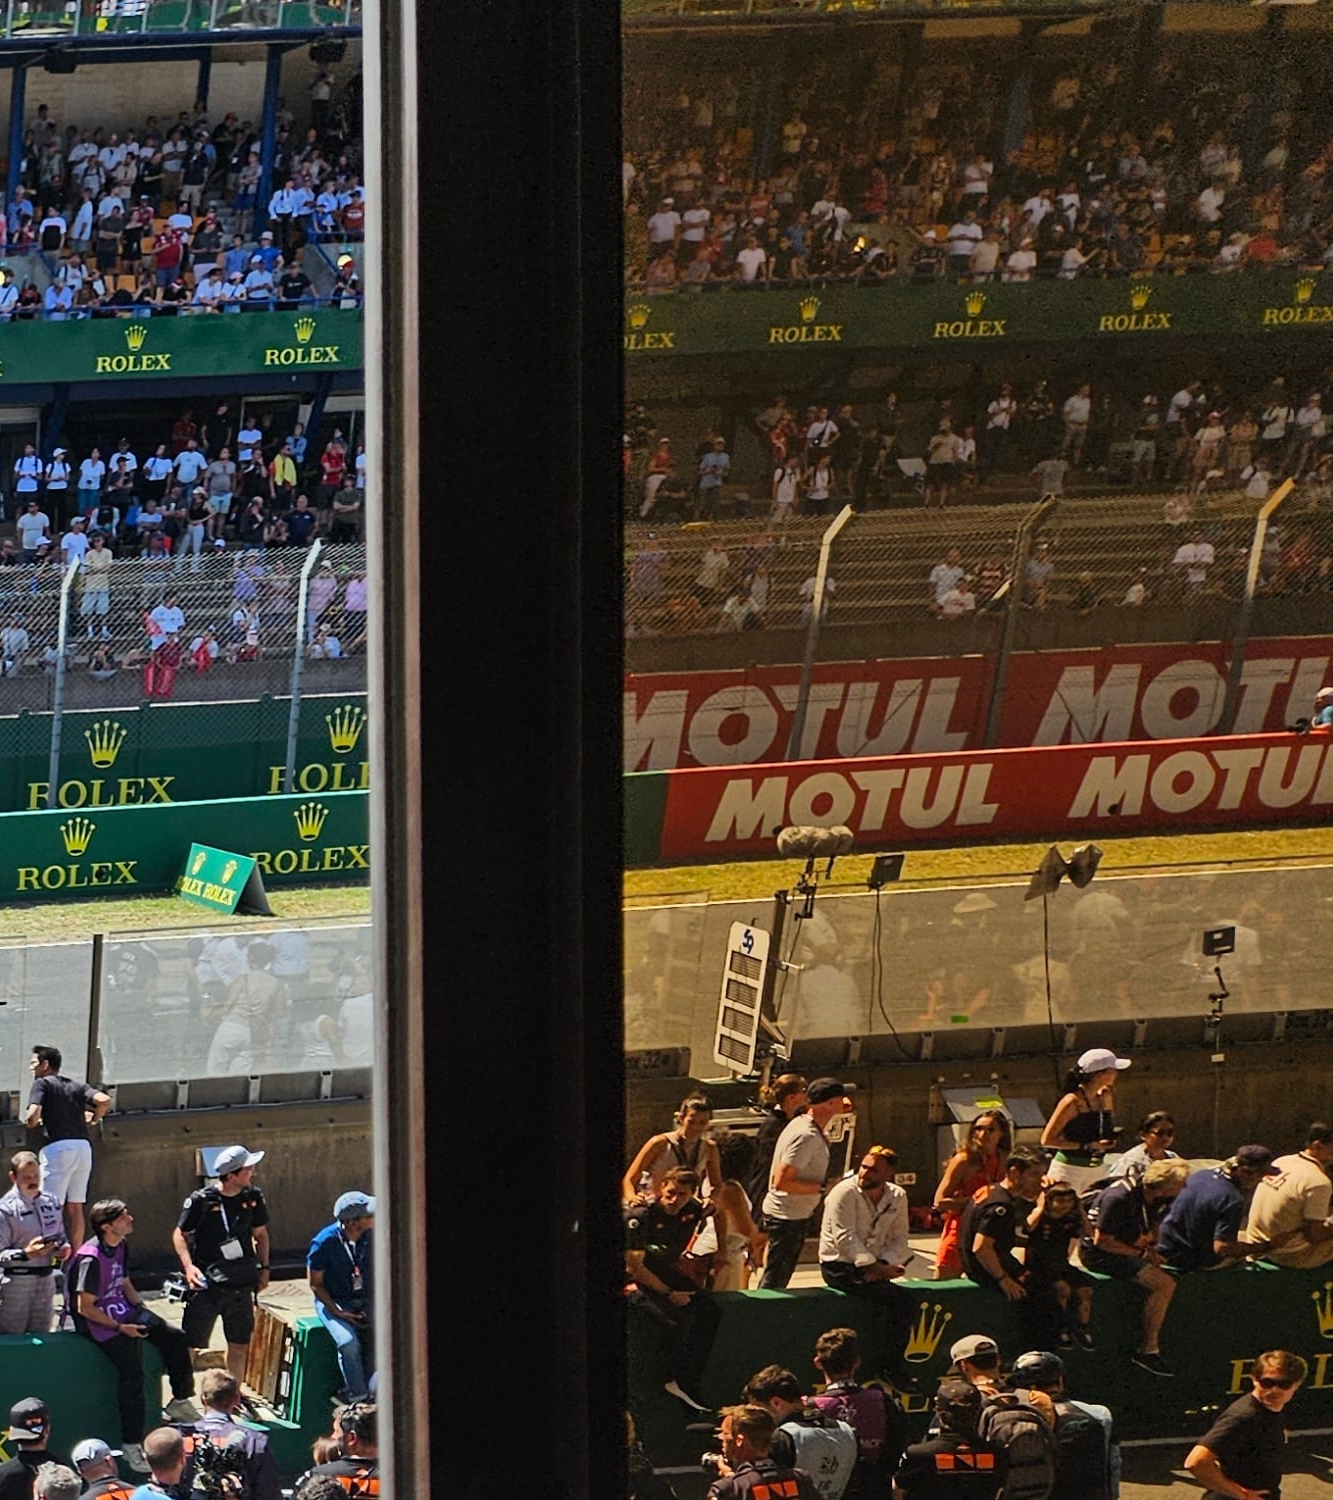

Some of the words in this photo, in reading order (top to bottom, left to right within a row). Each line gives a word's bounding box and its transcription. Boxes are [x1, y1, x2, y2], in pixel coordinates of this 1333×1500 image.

[934, 320, 1006, 339] ROLEX
[1098, 313, 1171, 332] ROLEX
[769, 325, 843, 345] ROLEX
[96, 353, 171, 373] ROLEX
[264, 346, 340, 366] ROLEX
[1066, 743, 1333, 819] MOTU
[27, 776, 175, 811] ROLEX
[705, 763, 1000, 841] MOTUL
[249, 845, 369, 874] ROLEX
[16, 861, 137, 891] ROLEX
[202, 882, 237, 906] ROLEX
